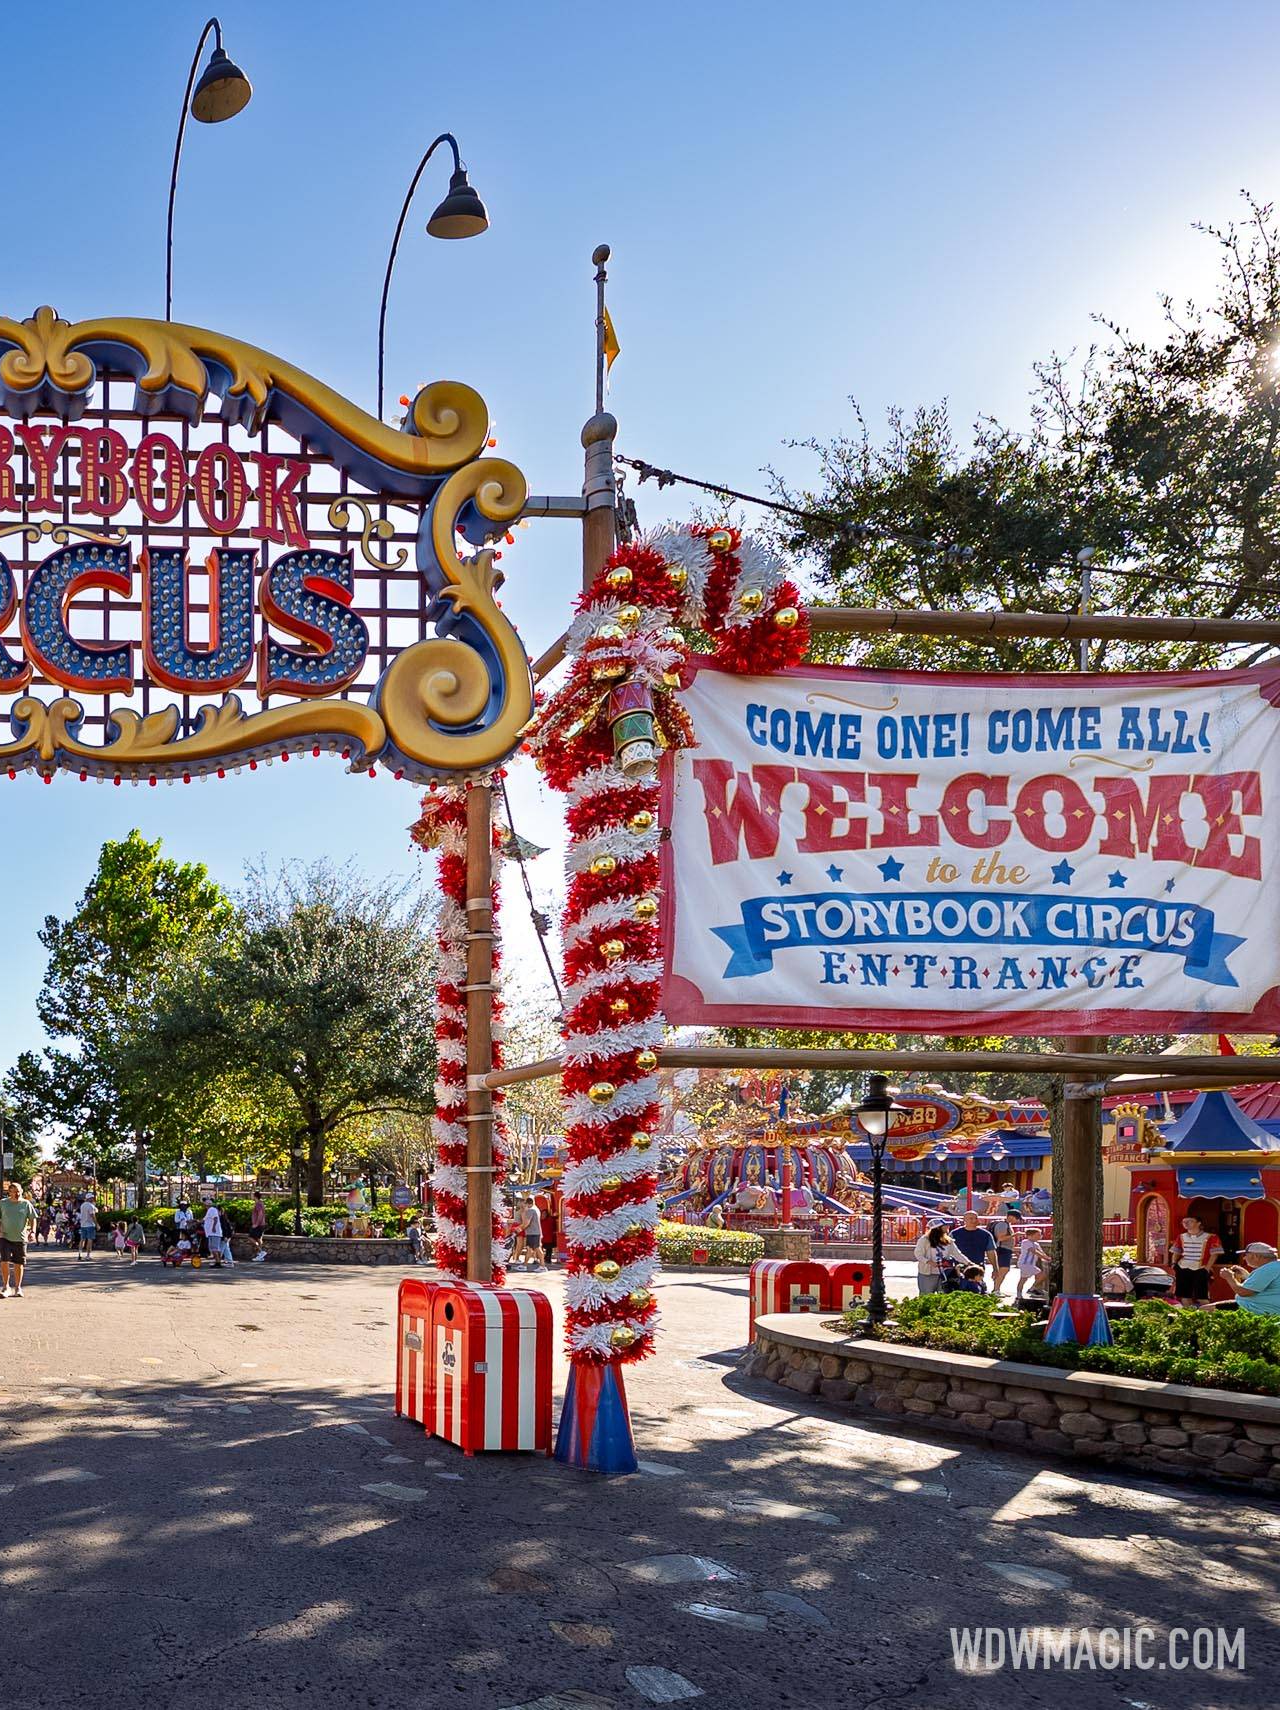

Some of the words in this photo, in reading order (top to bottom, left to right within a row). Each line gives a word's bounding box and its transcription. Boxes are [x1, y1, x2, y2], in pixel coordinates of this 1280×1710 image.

[746, 702, 862, 760] COME
[876, 711, 970, 760] ONE!
[987, 706, 1102, 754] COME
[1118, 706, 1211, 754] ALL!
[693, 758, 1263, 881] WELCOME
[925, 855, 962, 885] to
[971, 850, 1032, 885] the
[761, 898, 1032, 942] STORYBOOK
[1045, 903, 1195, 947] CIRCUS
